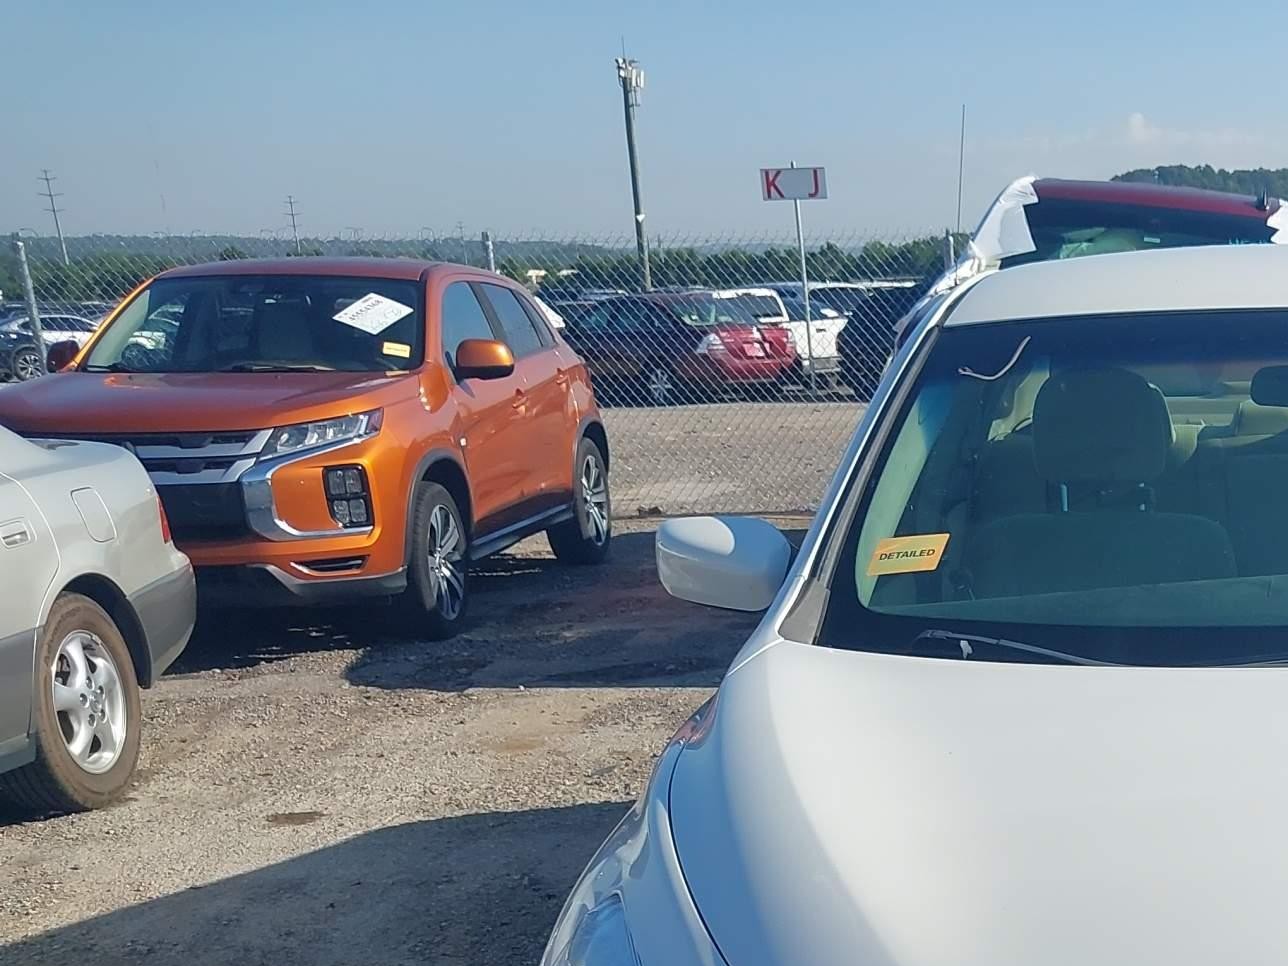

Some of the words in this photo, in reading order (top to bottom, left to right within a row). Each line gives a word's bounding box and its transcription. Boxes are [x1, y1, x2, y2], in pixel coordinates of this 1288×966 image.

[764, 169, 785, 199] K
[808, 168, 819, 198] J
[879, 548, 936, 561] DETAILED
